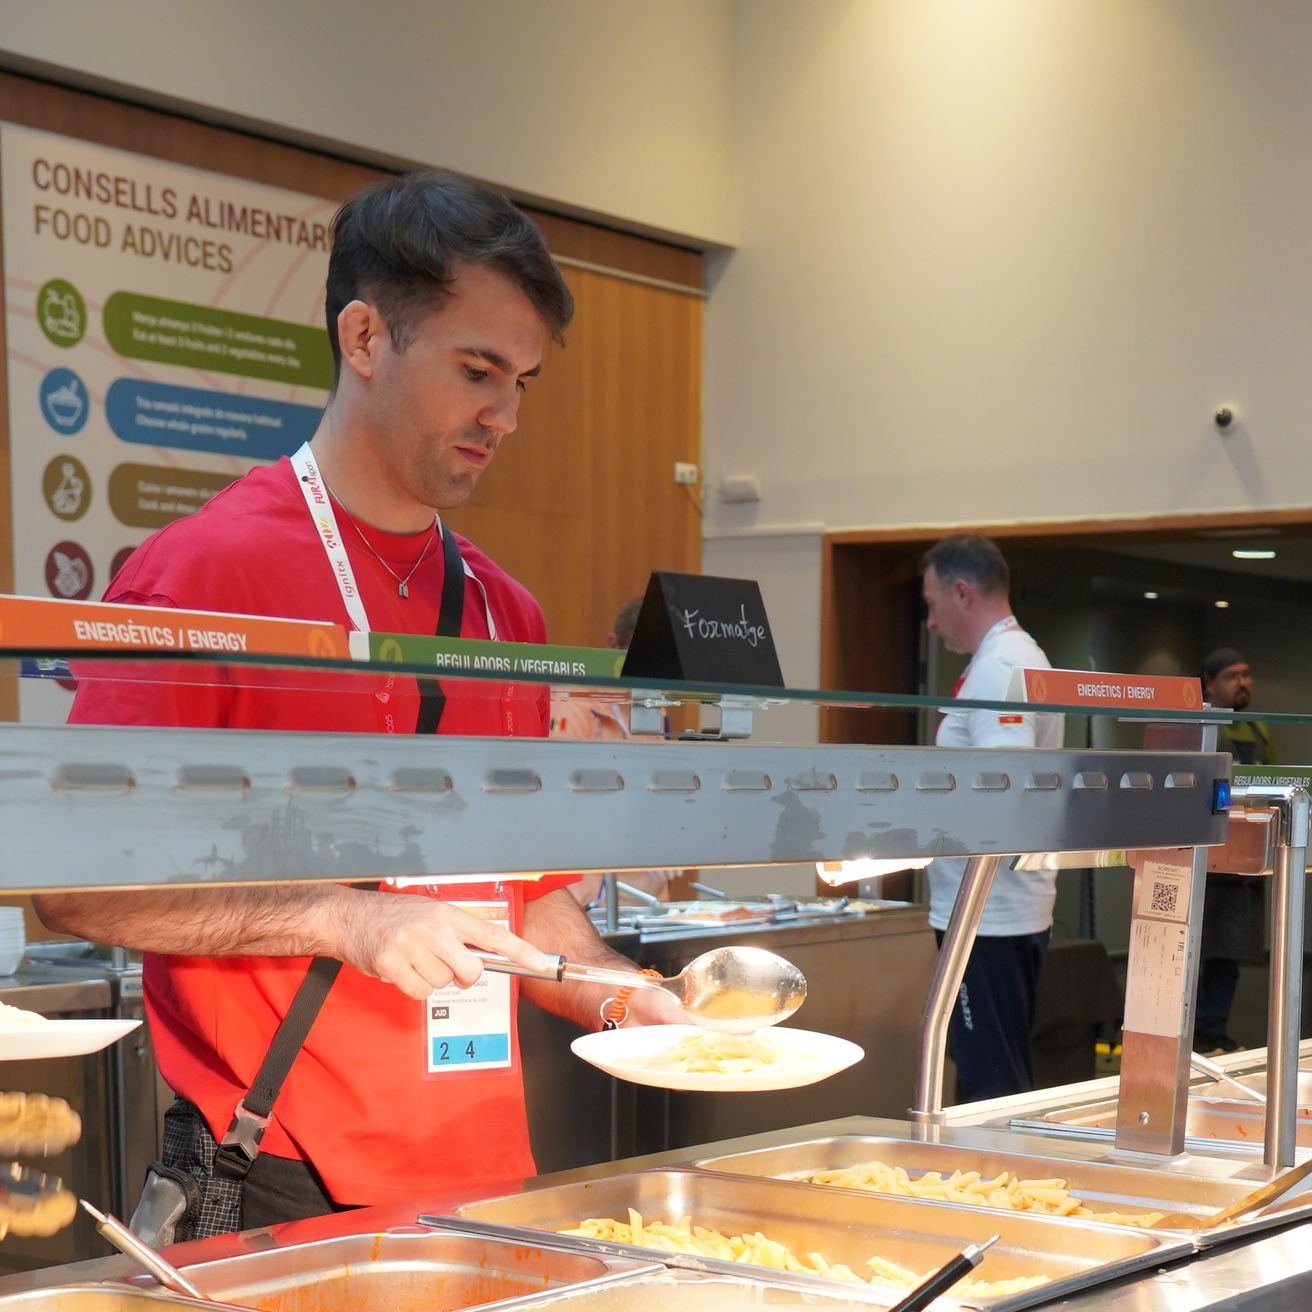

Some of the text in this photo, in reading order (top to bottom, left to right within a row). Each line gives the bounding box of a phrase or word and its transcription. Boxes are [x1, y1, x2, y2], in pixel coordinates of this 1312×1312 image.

[32, 159, 331, 252] CONSELLS ALIMENTAR
[34, 205, 234, 274] FOOD ADVICES
[73, 619, 248, 651] ENERGÈTICS / ENERGY
[683, 603, 767, 647] Formatge
[1077, 680, 1122, 698] ENERGÈTICS
[1127, 686, 1155, 699] ENERGY
[440, 1040, 475, 1060] 2 4
